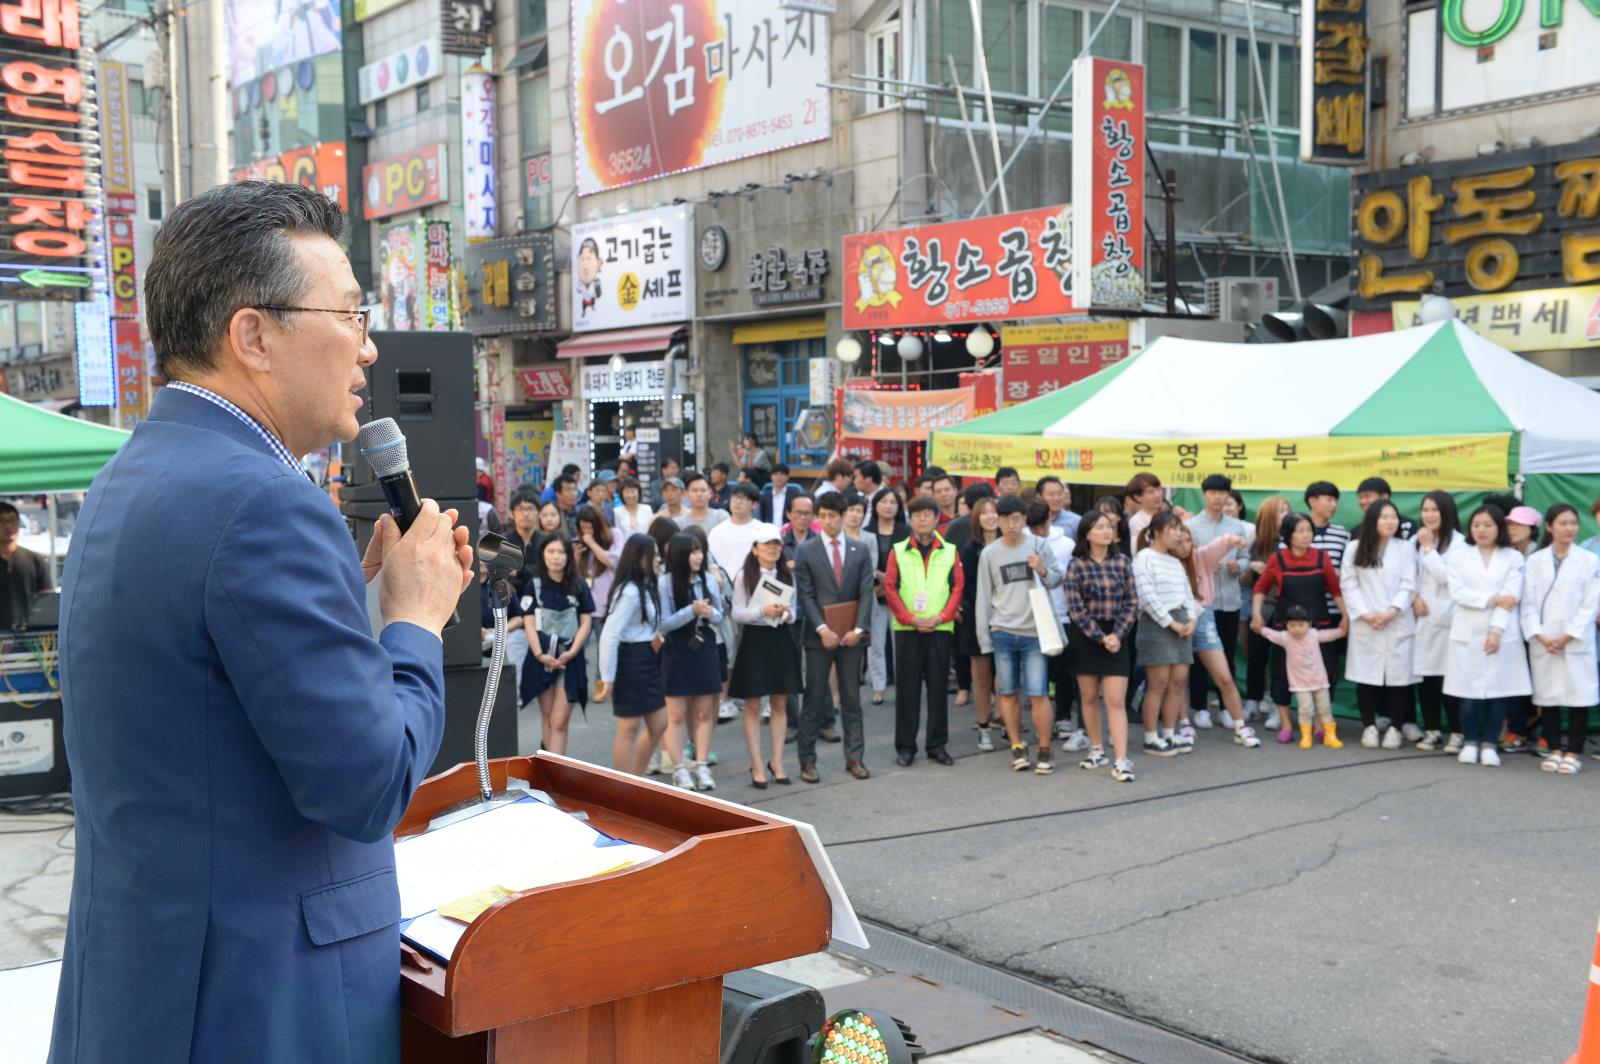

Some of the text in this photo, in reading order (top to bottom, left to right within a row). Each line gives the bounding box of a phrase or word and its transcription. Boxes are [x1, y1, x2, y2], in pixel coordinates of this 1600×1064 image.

[594, 4, 815, 116] 오감 마사지
[1315, 0, 1371, 154] 갈비
[802, 96, 822, 125] 2F
[384, 158, 425, 205] PC
[1103, 115, 1134, 277] 황소곱창
[605, 227, 673, 264] 고기굽는
[112, 247, 134, 298] PC
[1132, 443, 1299, 470] 운영본부
